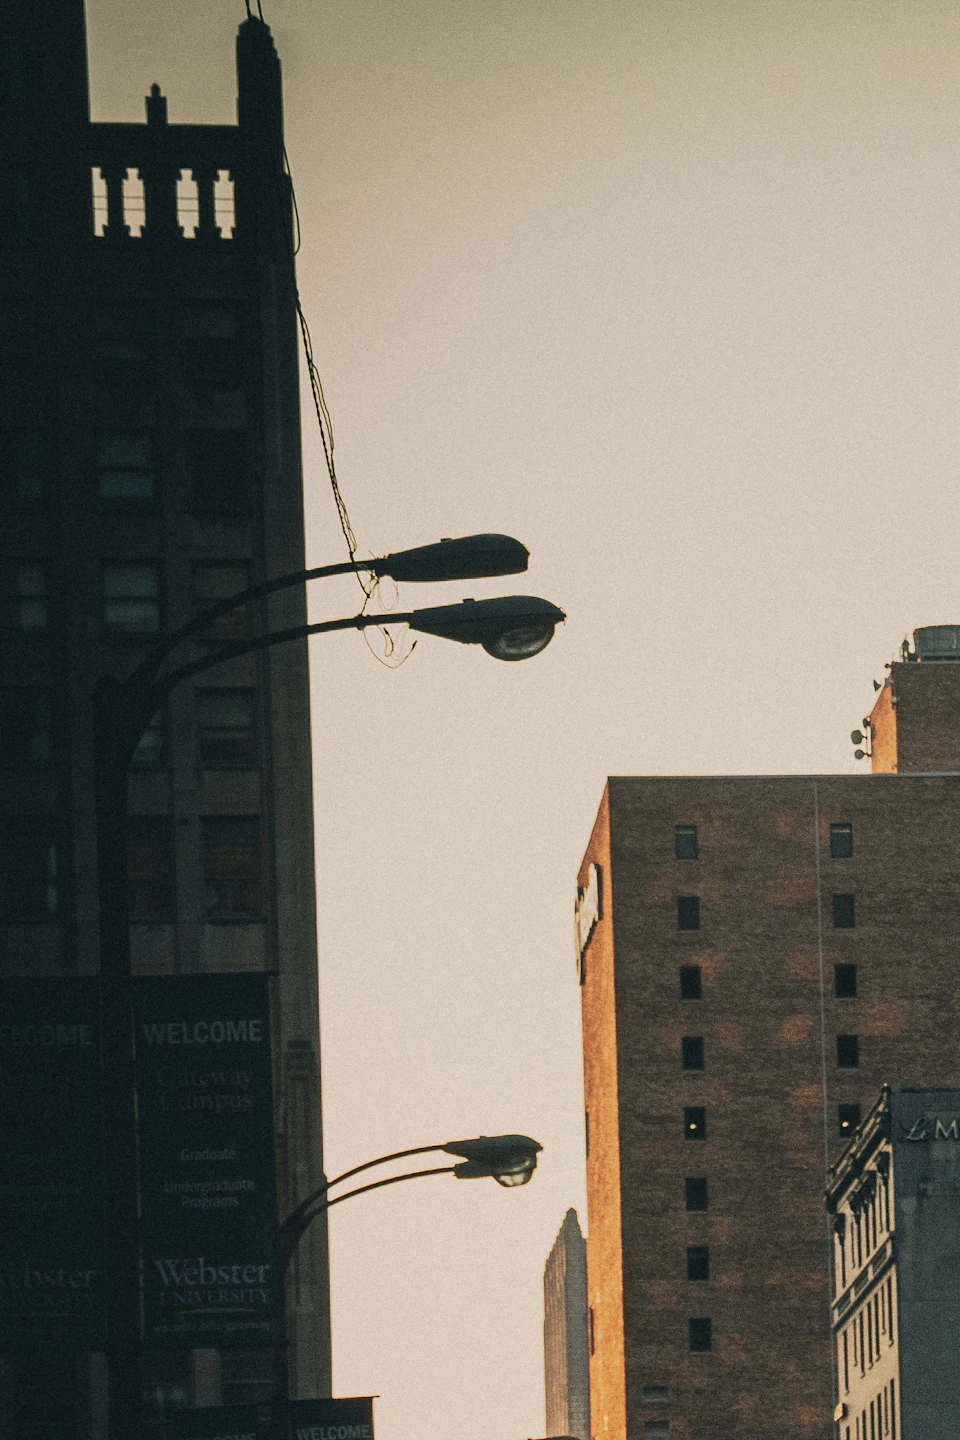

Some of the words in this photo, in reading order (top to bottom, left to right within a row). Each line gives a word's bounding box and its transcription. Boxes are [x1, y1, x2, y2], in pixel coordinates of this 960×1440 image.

[0, 1024, 93, 1046] ELCOME
[142, 1019, 263, 1044] WELCOME
[157, 1066, 250, 1091] Gateway
[160, 1091, 252, 1114] Campus
[904, 1118, 928, 1141] Le
[180, 1148, 237, 1161] Graduate
[164, 1177, 255, 1196] Undergraduate
[181, 1195, 239, 1211] Programs
[153, 1257, 271, 1286] Webster
[159, 1288, 271, 1307] UNIVERSITY
